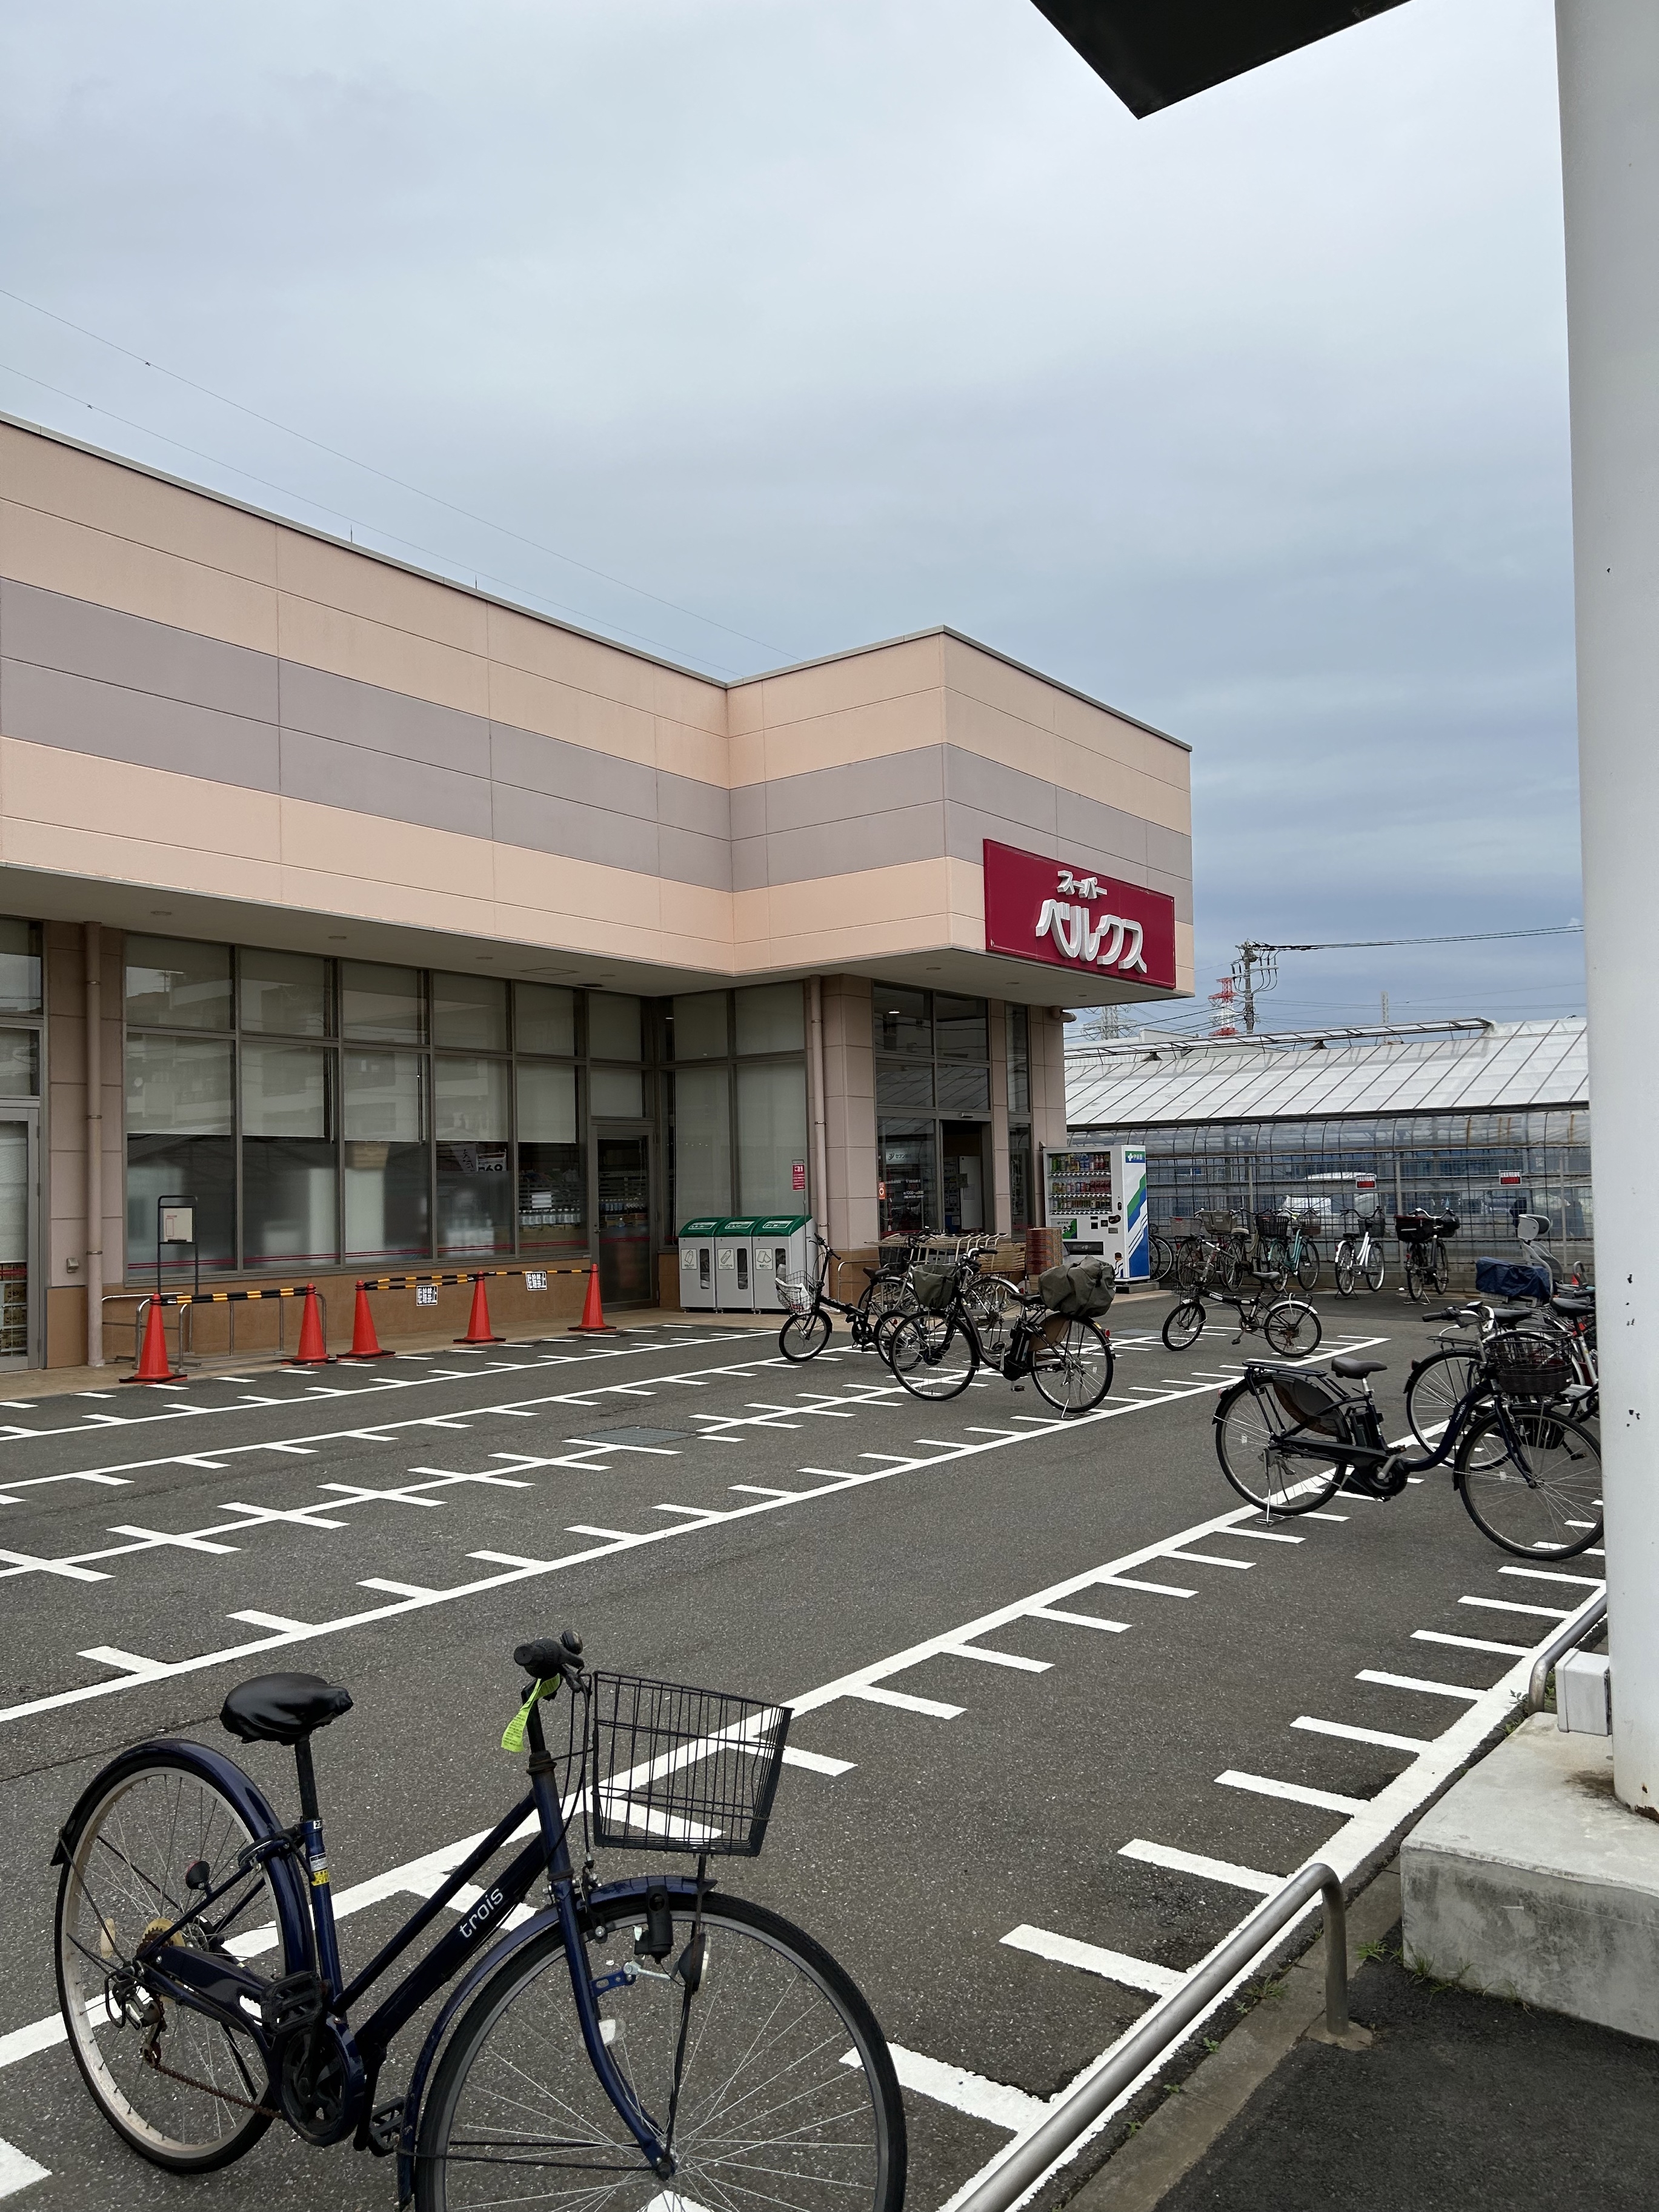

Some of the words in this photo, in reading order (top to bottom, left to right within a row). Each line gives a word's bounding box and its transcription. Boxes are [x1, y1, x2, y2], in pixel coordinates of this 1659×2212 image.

[1057, 870, 1108, 900] スーパー
[1036, 899, 1148, 974] ベルクス
[459, 1888, 504, 1938] trois
